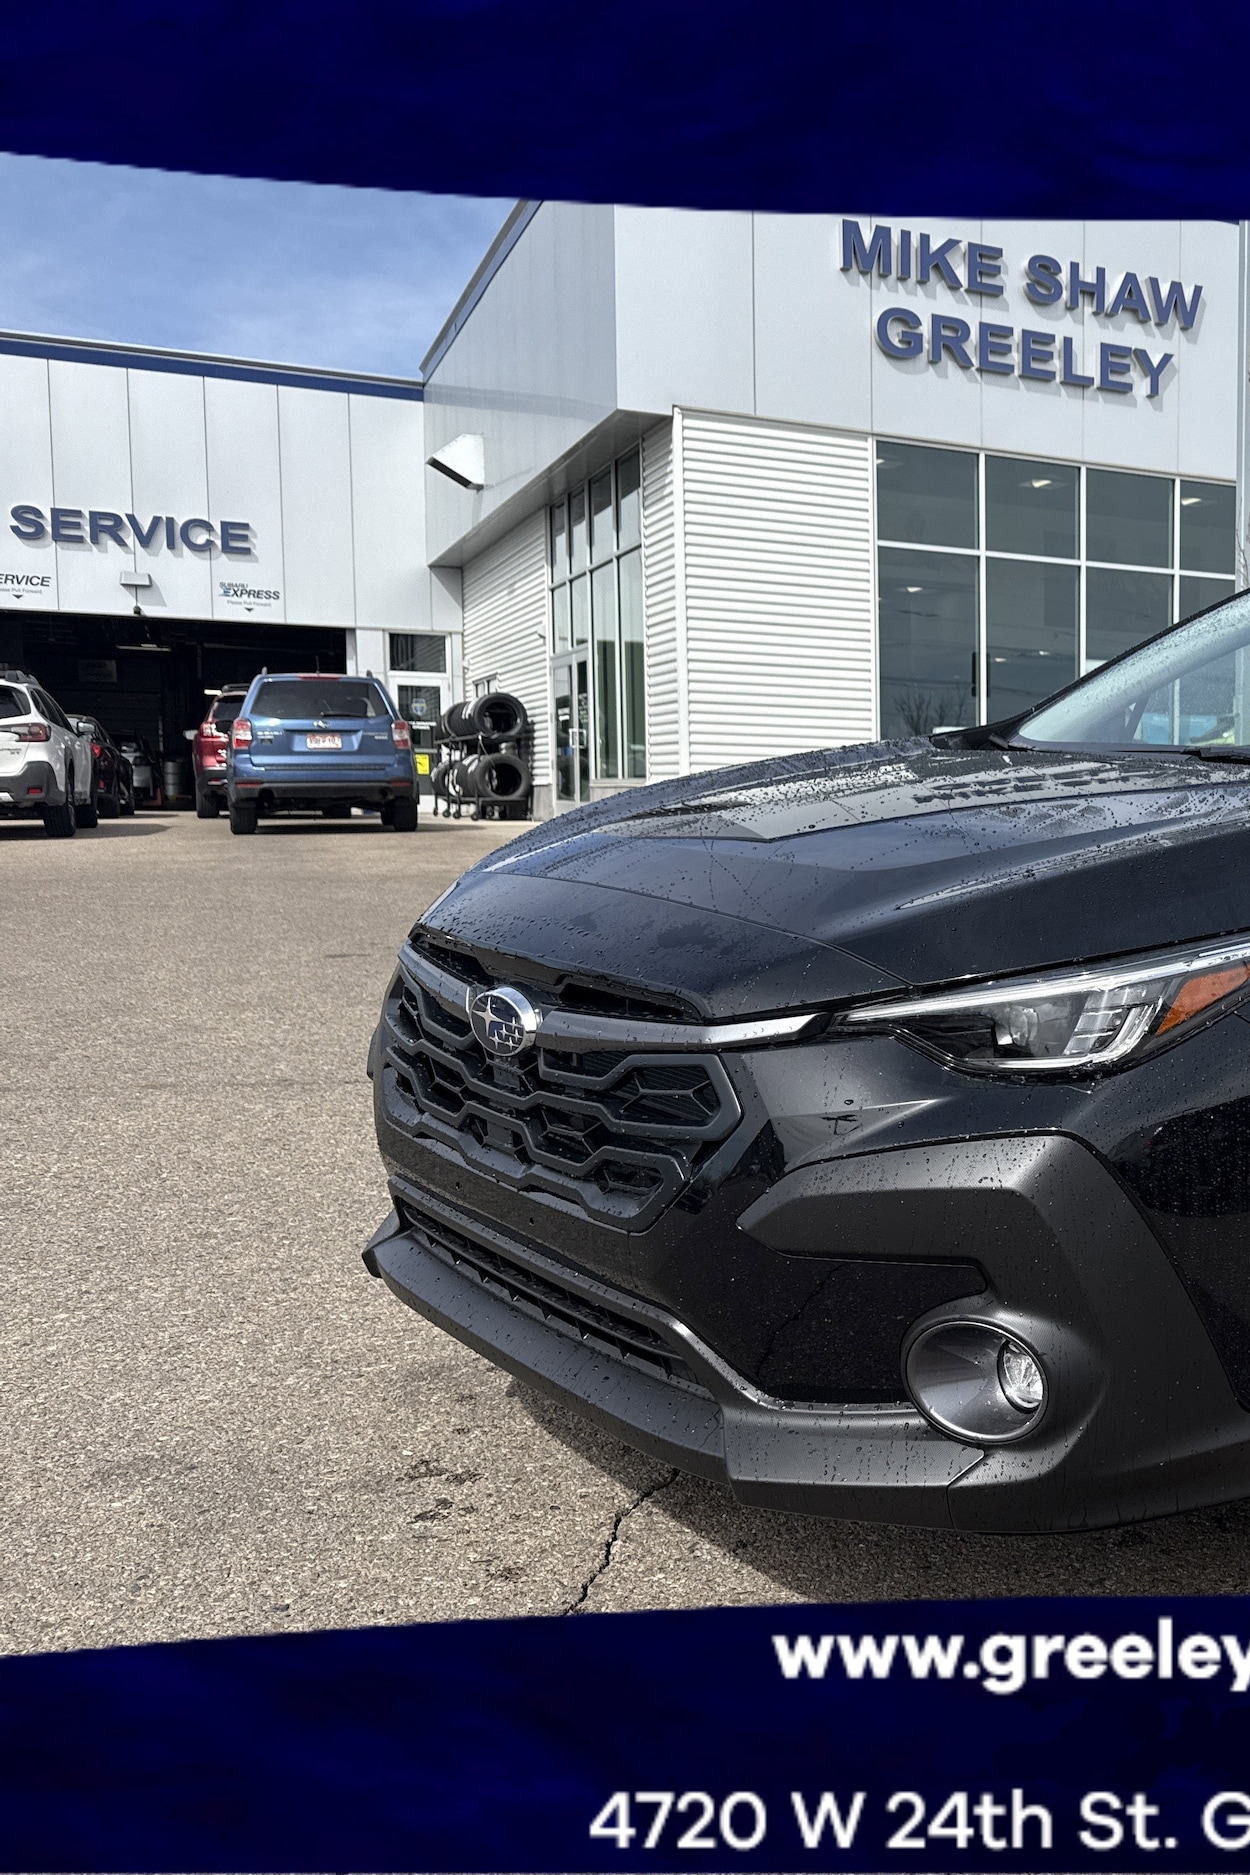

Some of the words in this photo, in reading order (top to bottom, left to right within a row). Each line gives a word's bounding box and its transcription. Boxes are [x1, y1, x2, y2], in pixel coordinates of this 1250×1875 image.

[842, 218, 1004, 297] MIKE
[1023, 254, 1203, 331] SHAW
[875, 307, 1175, 398] GREELEY
[10, 504, 252, 556] SERVICE
[219, 586, 280, 600] EXPRESS
